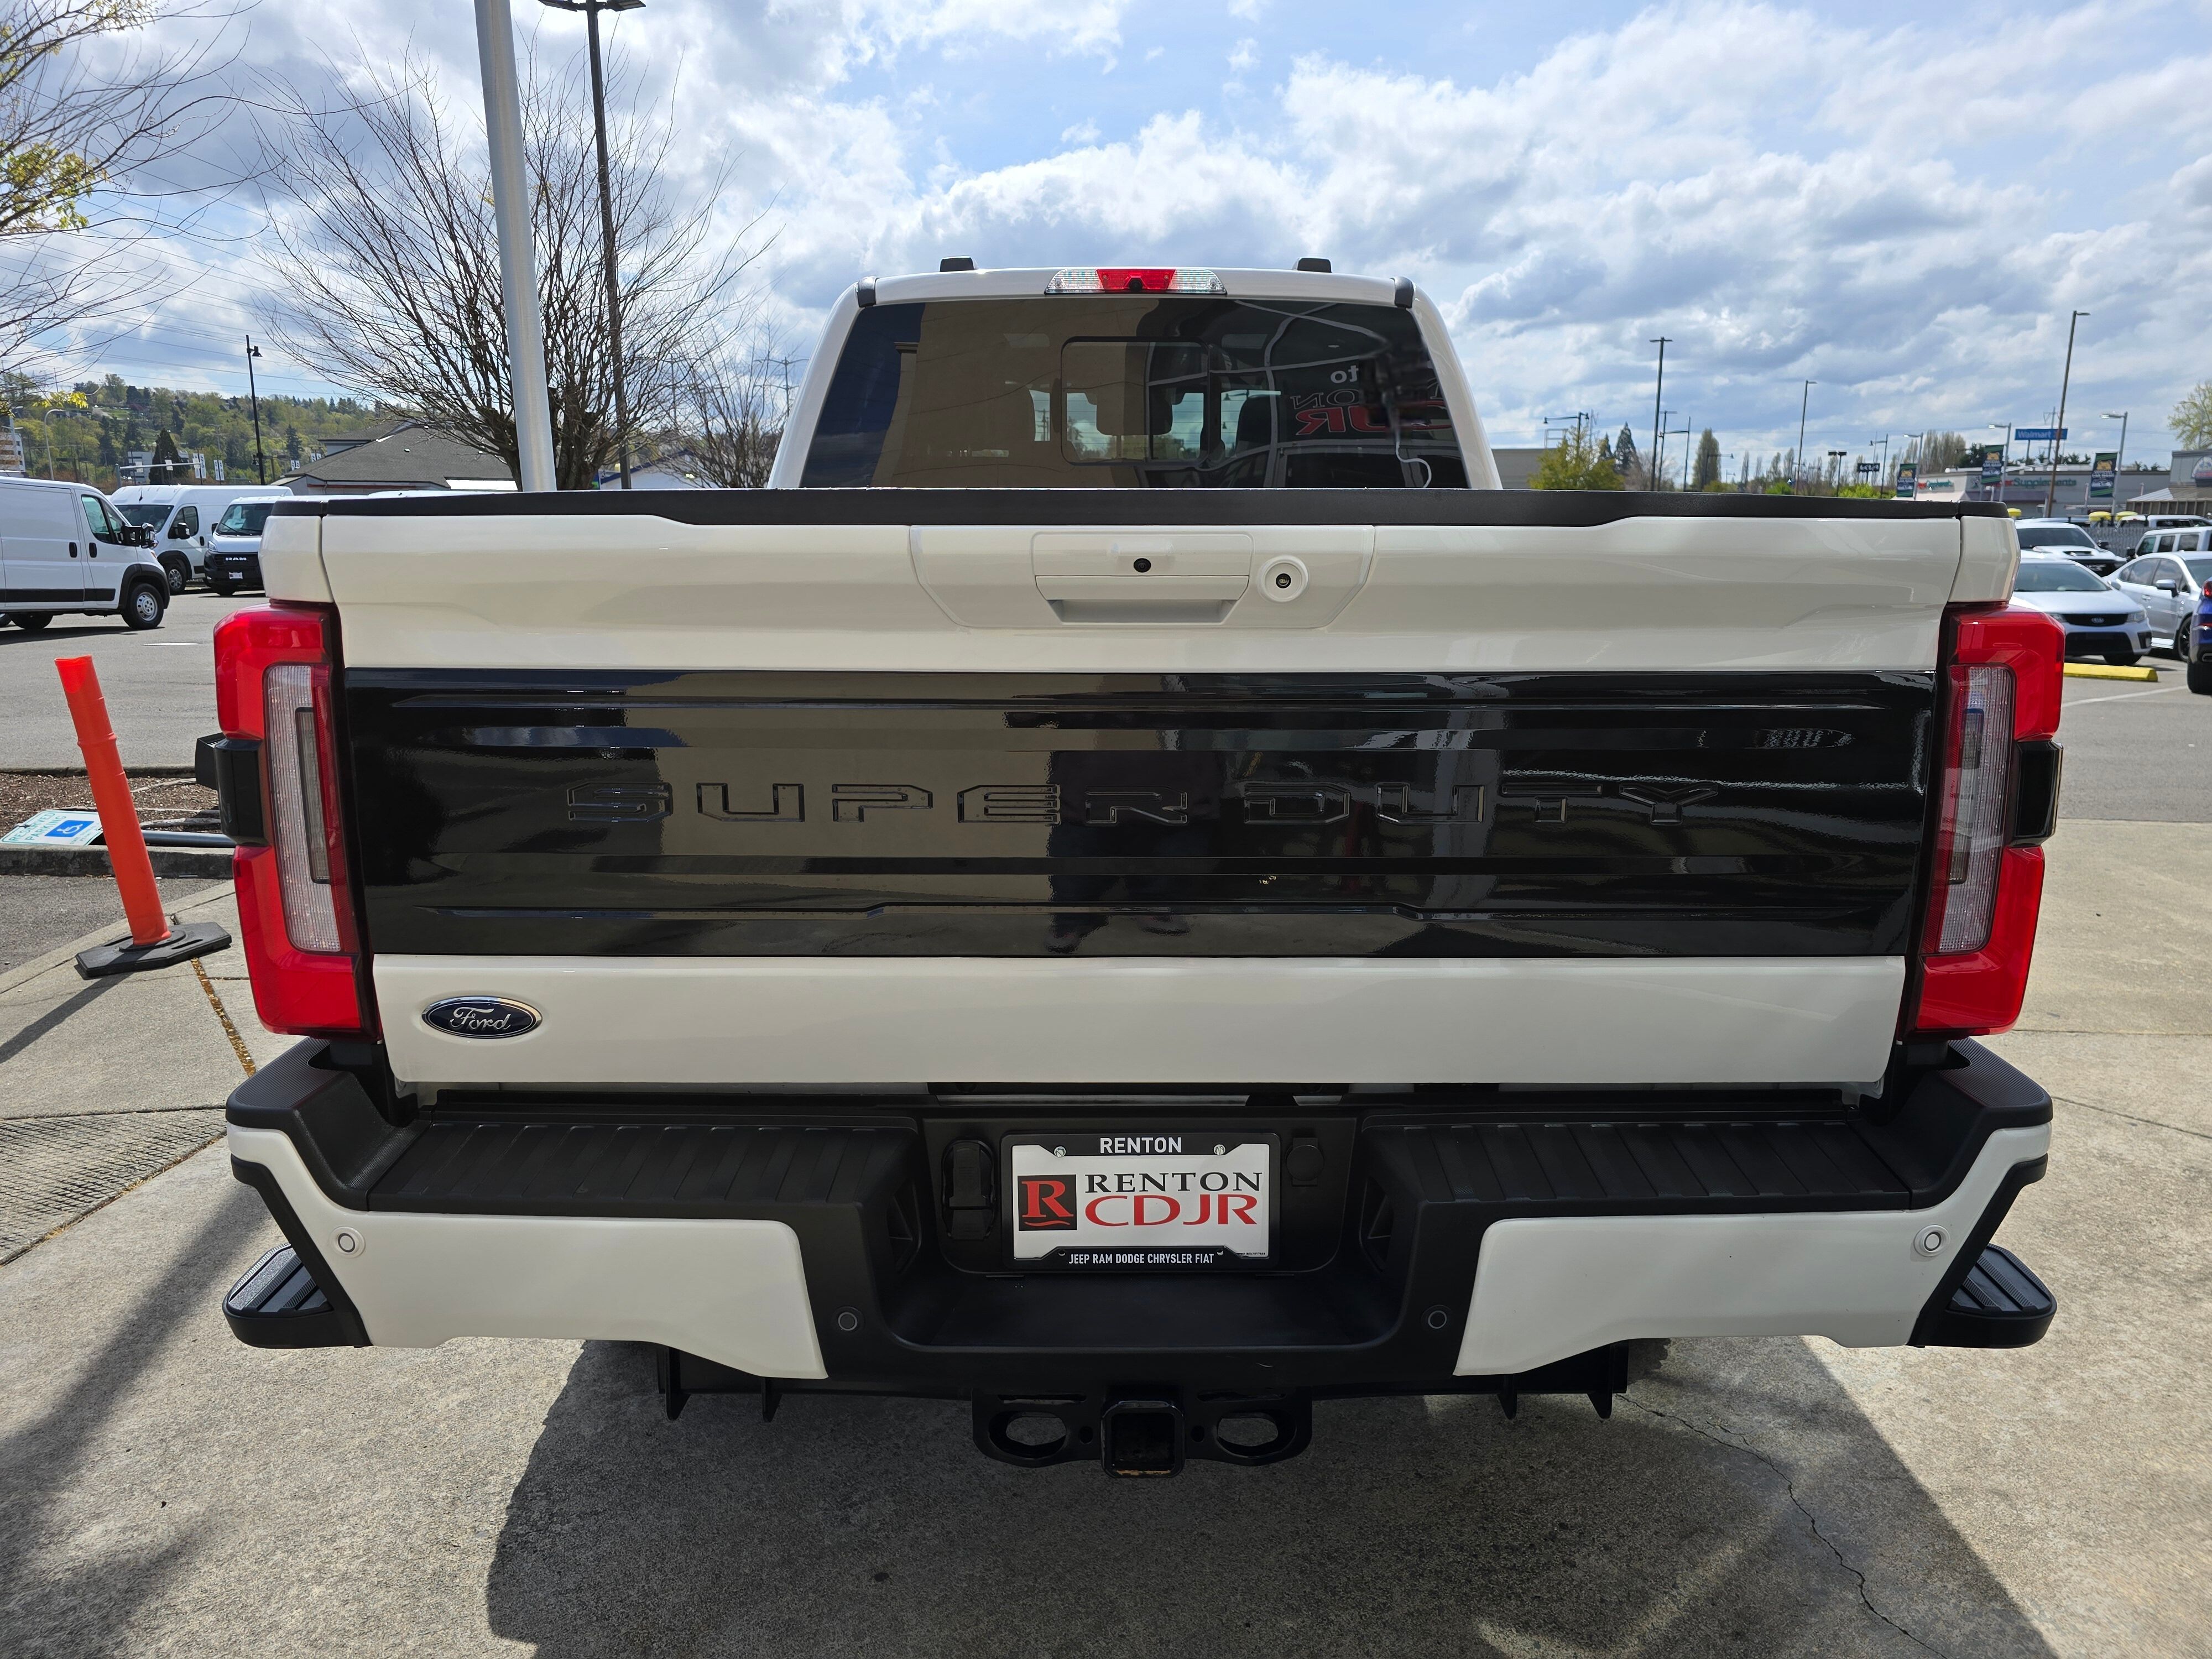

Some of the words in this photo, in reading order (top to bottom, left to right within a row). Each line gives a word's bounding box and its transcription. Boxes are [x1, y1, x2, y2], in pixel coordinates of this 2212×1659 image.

[2018, 430, 2051, 439] Walmart
[566, 781, 1188, 825] SUPER
[1243, 781, 1719, 826] DUTY
[24, 816, 67, 841] PARKING
[450, 1006, 512, 1030] Ford
[1099, 1137, 1182, 1154] RENTON
[1084, 1172, 1263, 1193] RENTON
[1021, 1181, 1074, 1218] R
[1084, 1193, 1258, 1227] CDJR
[1068, 1254, 1090, 1264] JEEP
[1093, 1254, 1113, 1264] RAM
[1115, 1254, 1145, 1264] DODGE
[1147, 1253, 1192, 1264] CHRYSLER
[1195, 1253, 1214, 1264] FIAT
